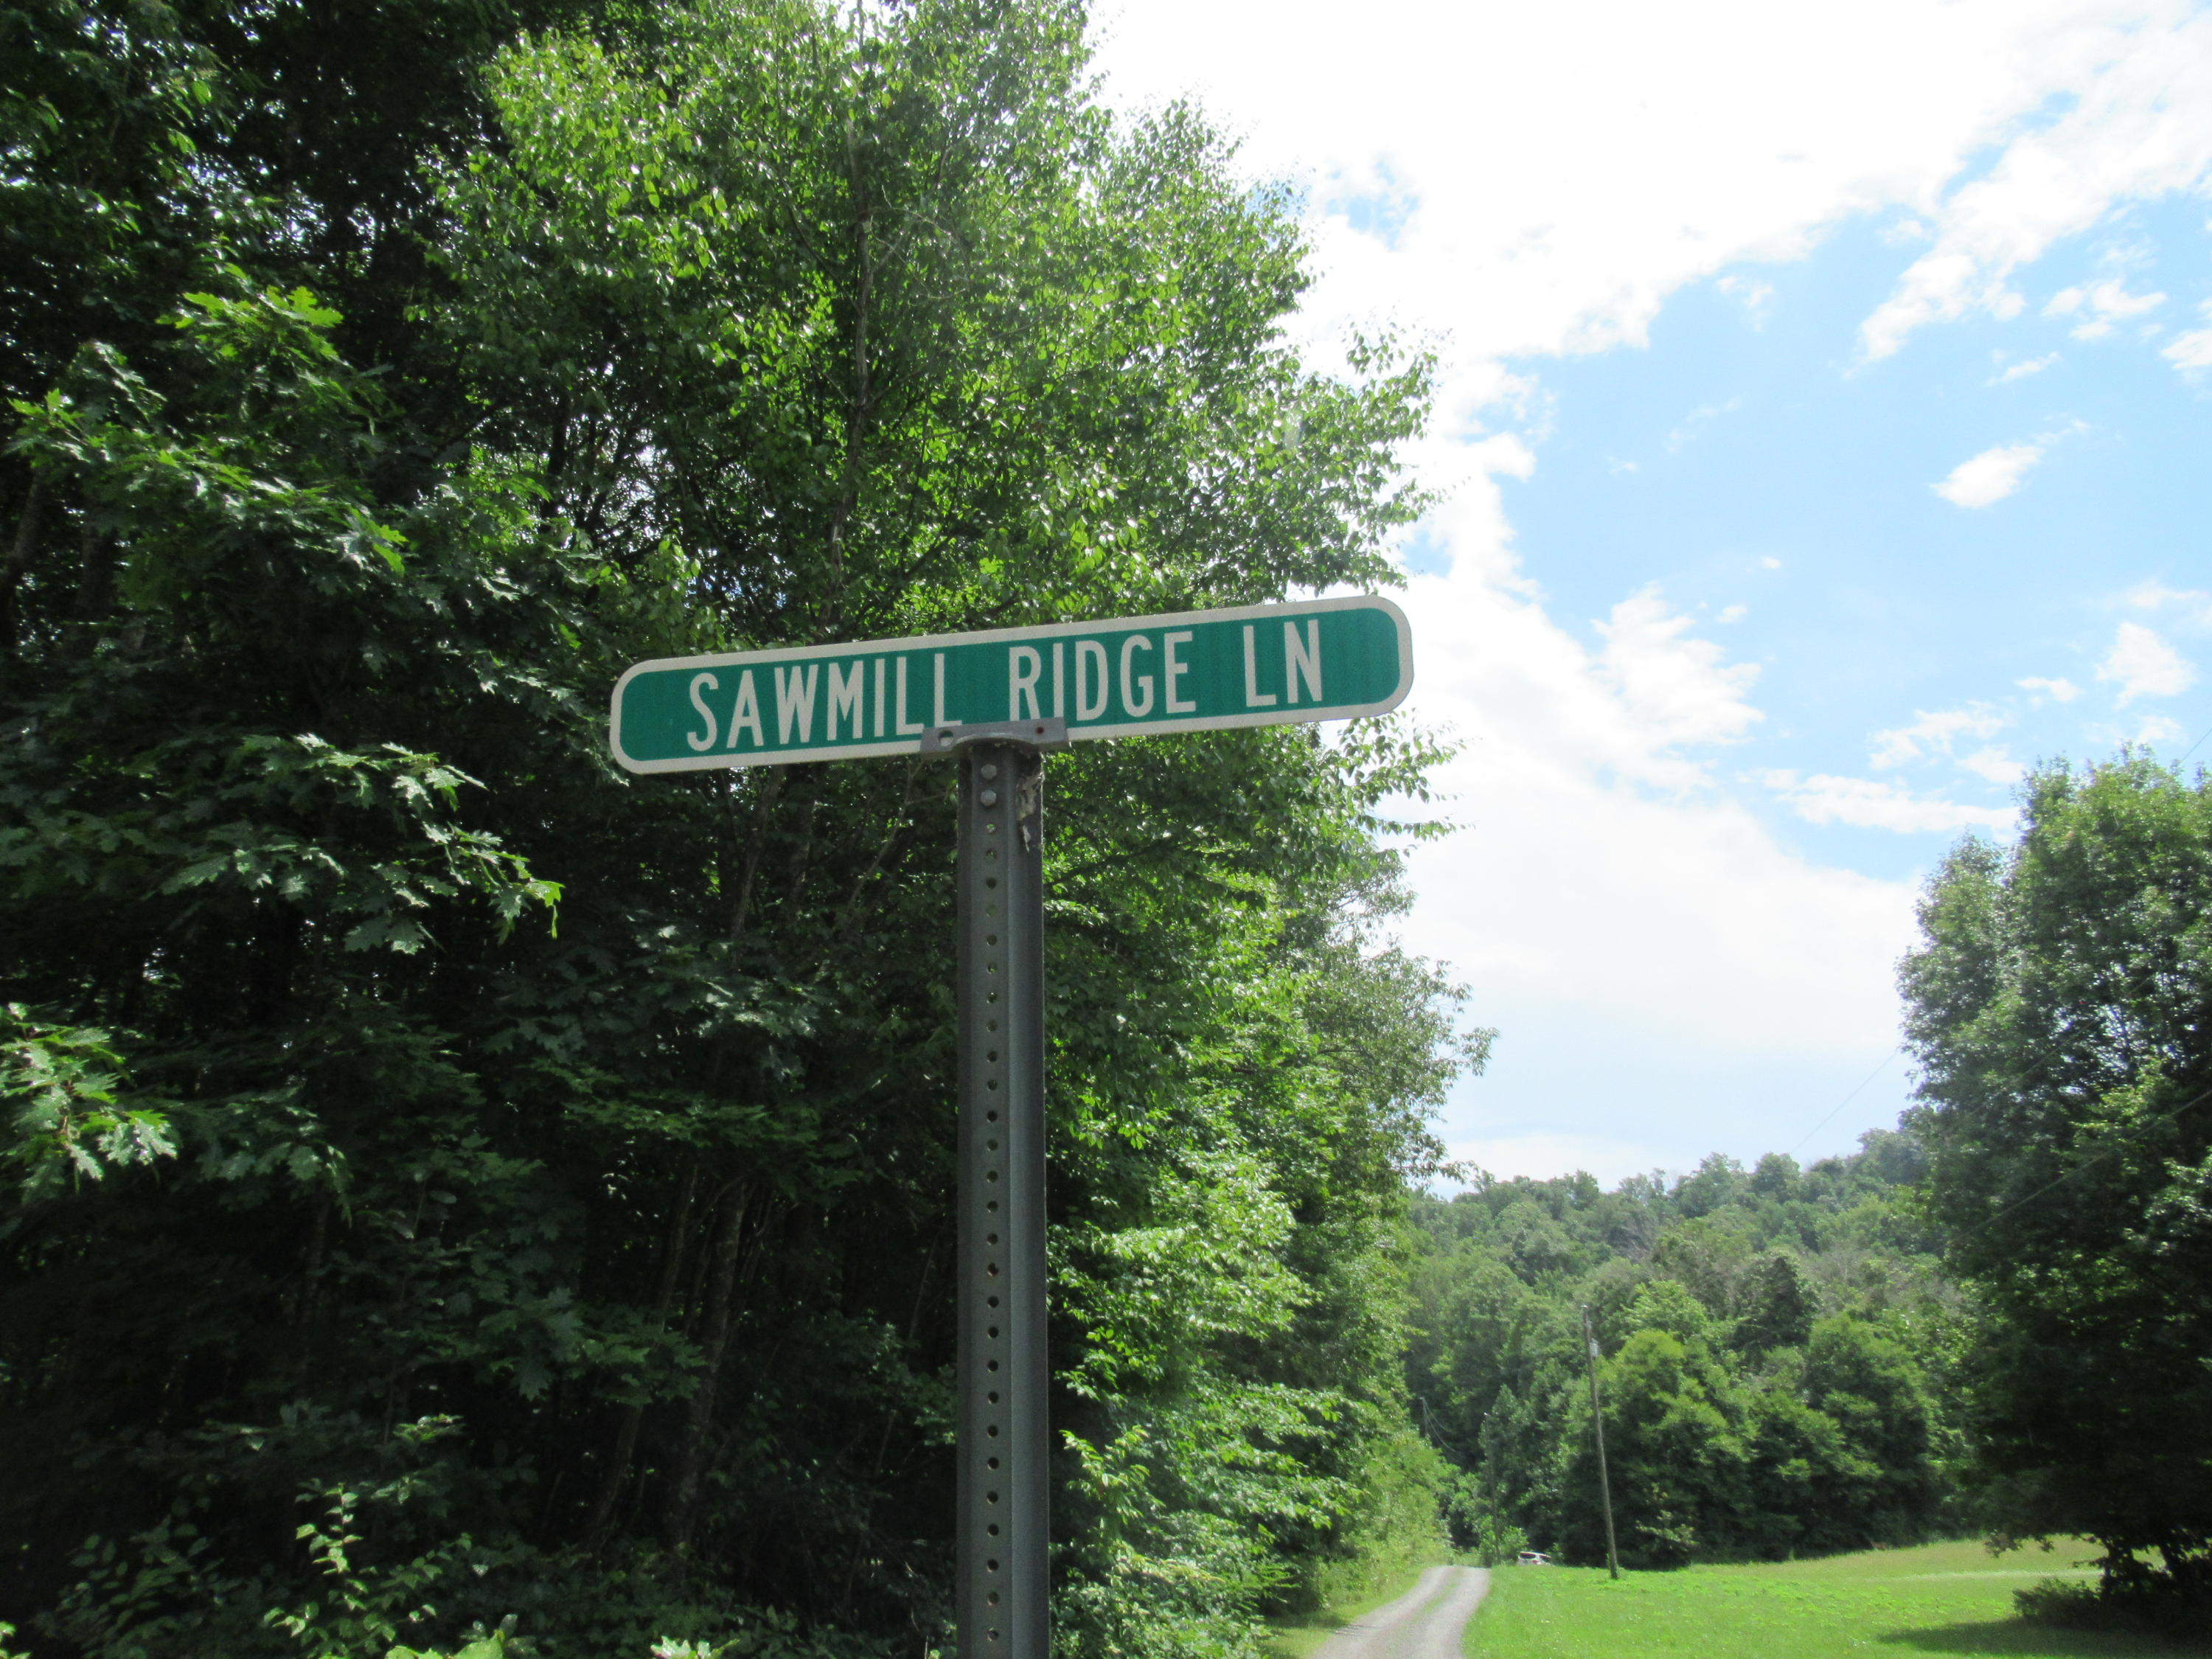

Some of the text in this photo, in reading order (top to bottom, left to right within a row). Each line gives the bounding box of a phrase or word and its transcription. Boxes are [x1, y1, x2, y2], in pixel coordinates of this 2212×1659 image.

[686, 618, 1323, 753] SAWMILL RIDGE LN
